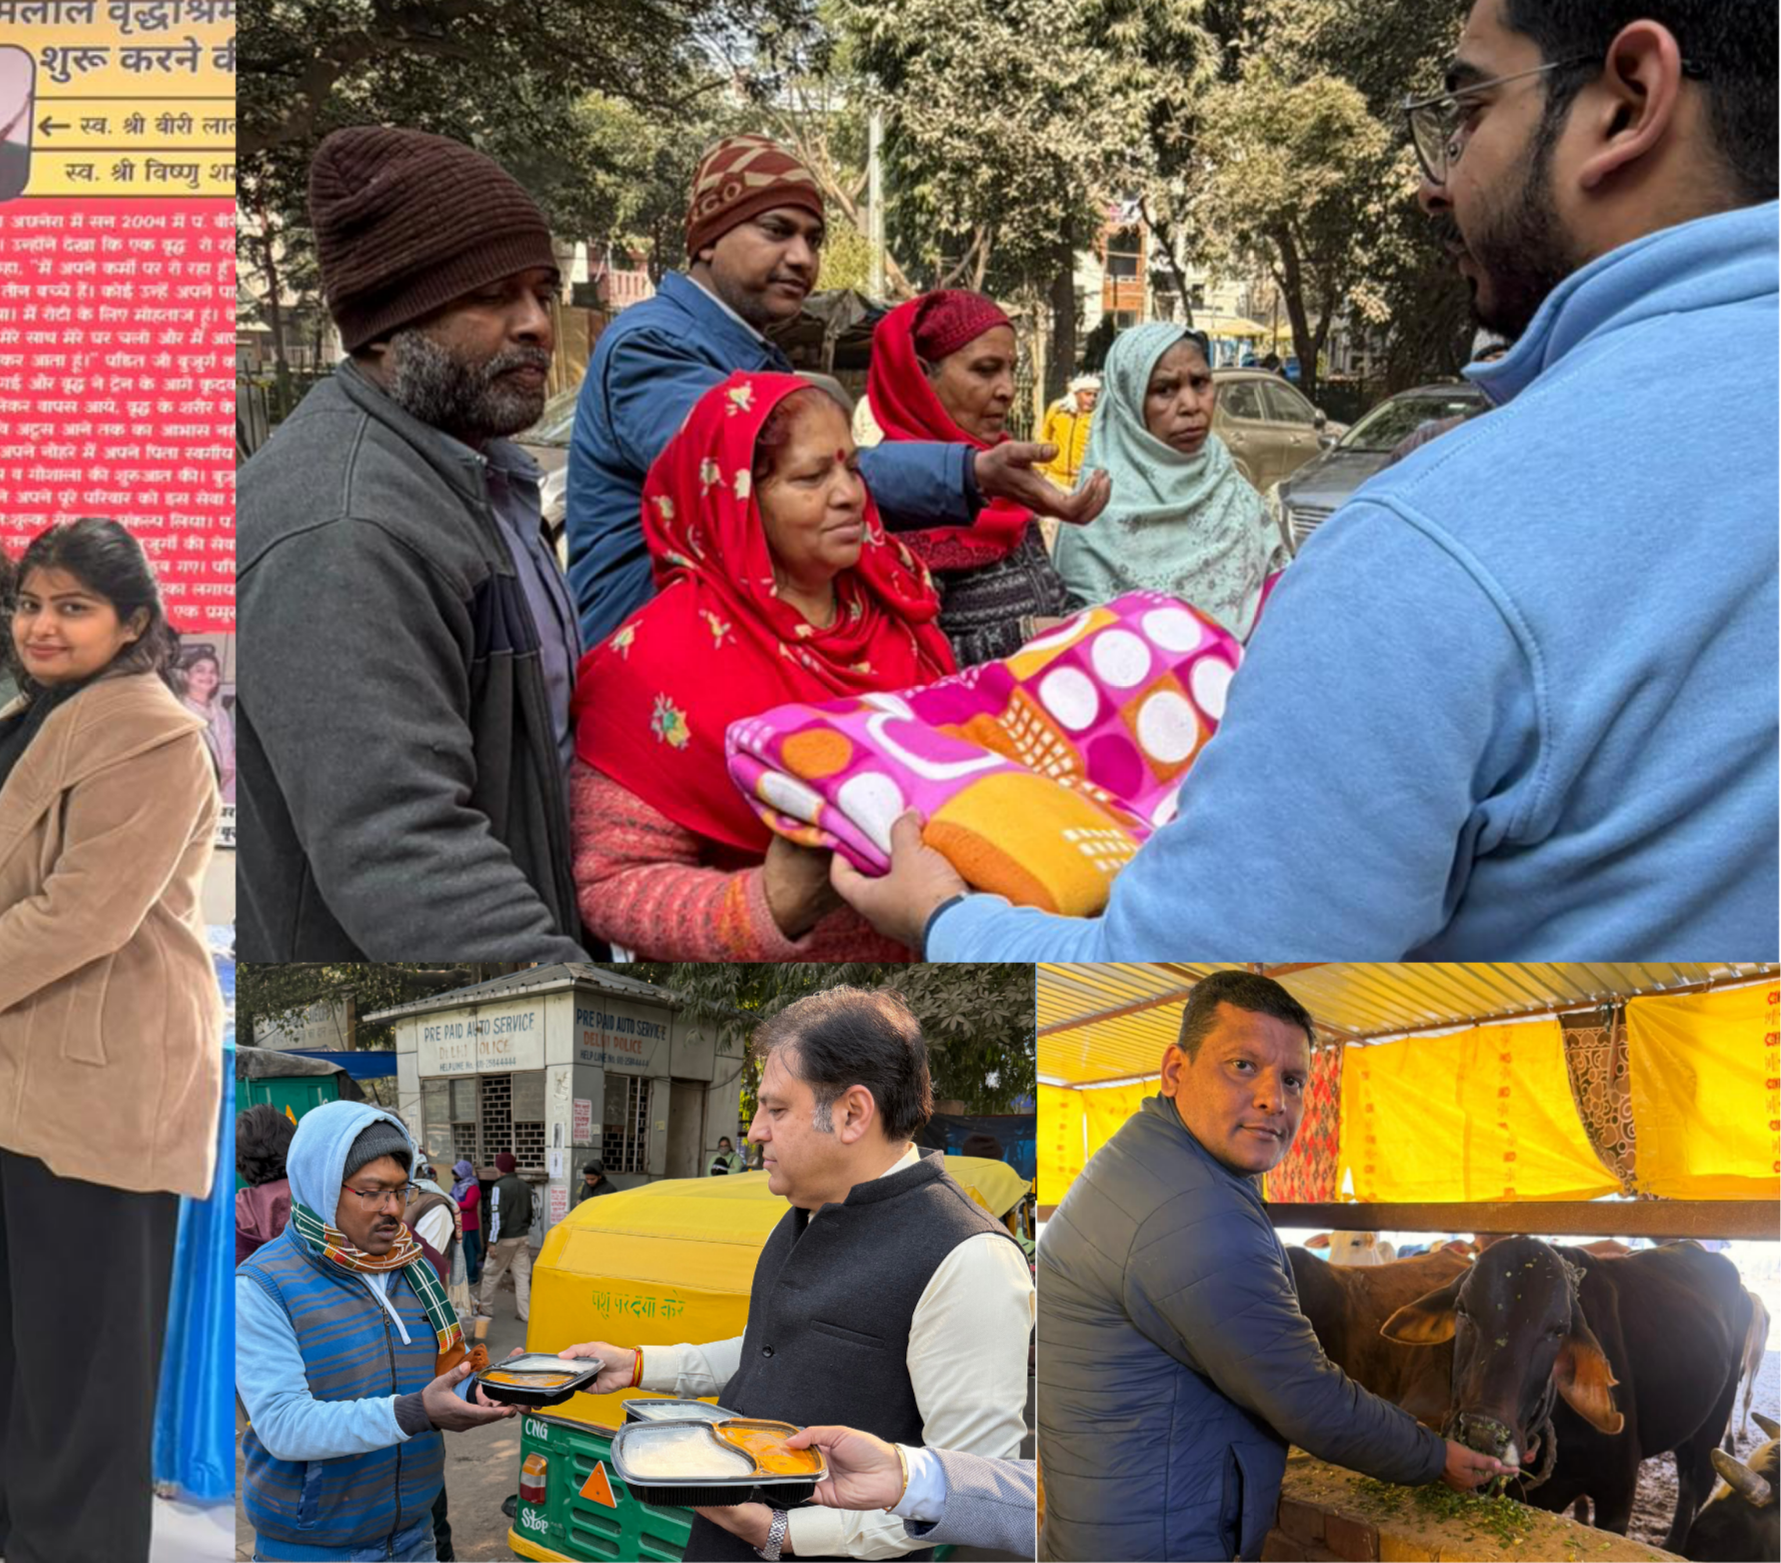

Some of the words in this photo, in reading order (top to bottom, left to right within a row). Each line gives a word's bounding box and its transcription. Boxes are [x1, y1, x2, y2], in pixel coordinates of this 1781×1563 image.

[40, 45, 110, 83] शुरू
[119, 37, 202, 72] करने
[80, 117, 113, 135] स्व.
[123, 112, 145, 135] श्री
[65, 163, 99, 182] स्व.
[110, 158, 134, 181] श्री
[145, 158, 200, 189] विष्णु
[424, 1026, 441, 1042] PRE
[444, 1023, 463, 1040] PAID
[466, 1019, 490, 1038] AUTO
[493, 1012, 535, 1035] SERVICE
[576, 1008, 595, 1028] PRE
[596, 1011, 616, 1031] PAID
[616, 1015, 635, 1036] AUTO
[613, 1036, 643, 1055] POLICE
[525, 1418, 548, 1441] CNG
